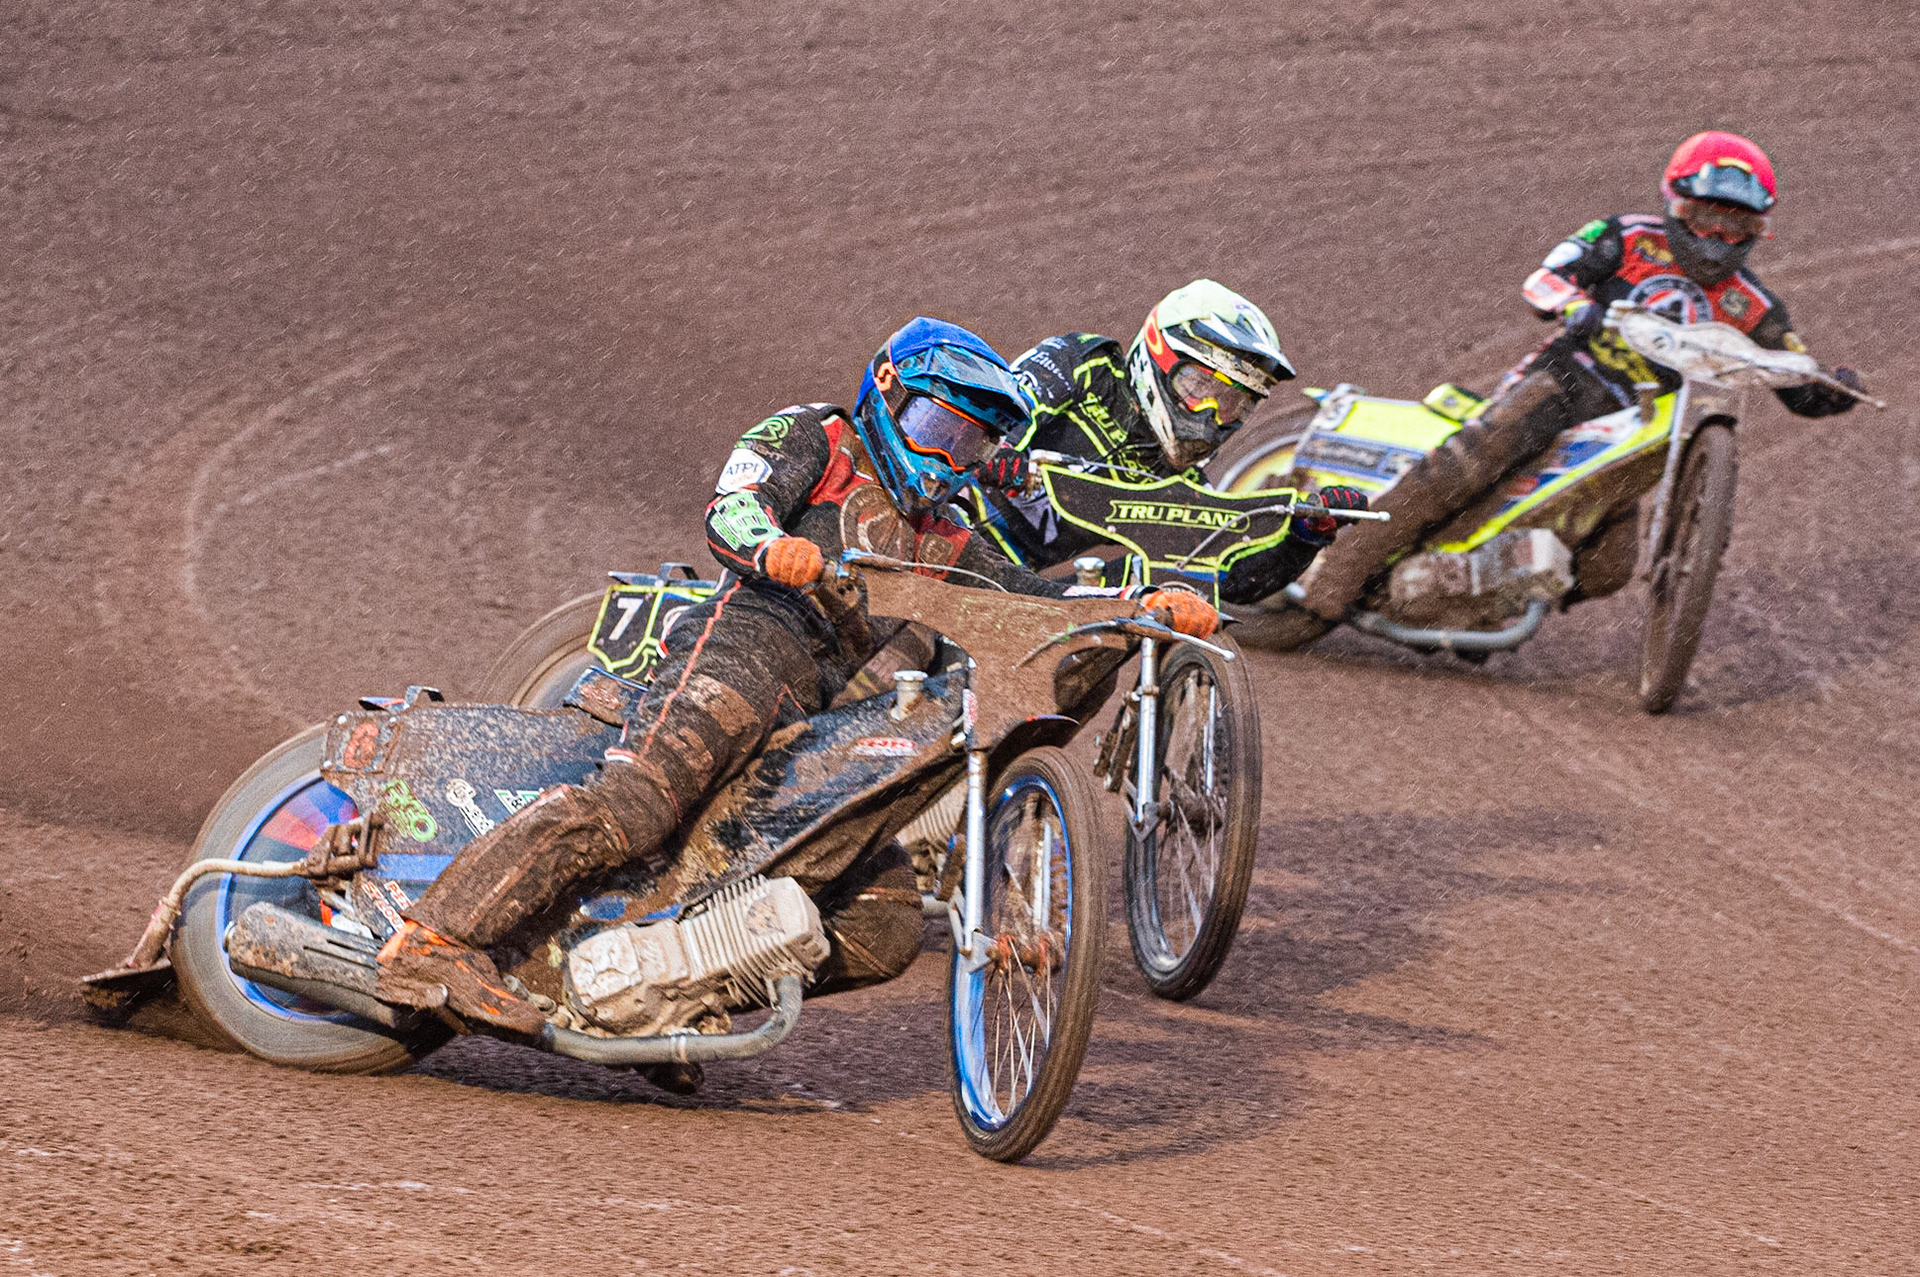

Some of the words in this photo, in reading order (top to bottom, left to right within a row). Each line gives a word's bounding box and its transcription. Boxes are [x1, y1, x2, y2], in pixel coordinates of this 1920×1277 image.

[1118, 504, 1163, 520] TRU
[1166, 507, 1239, 529] PLANT
[609, 597, 644, 640] 7
